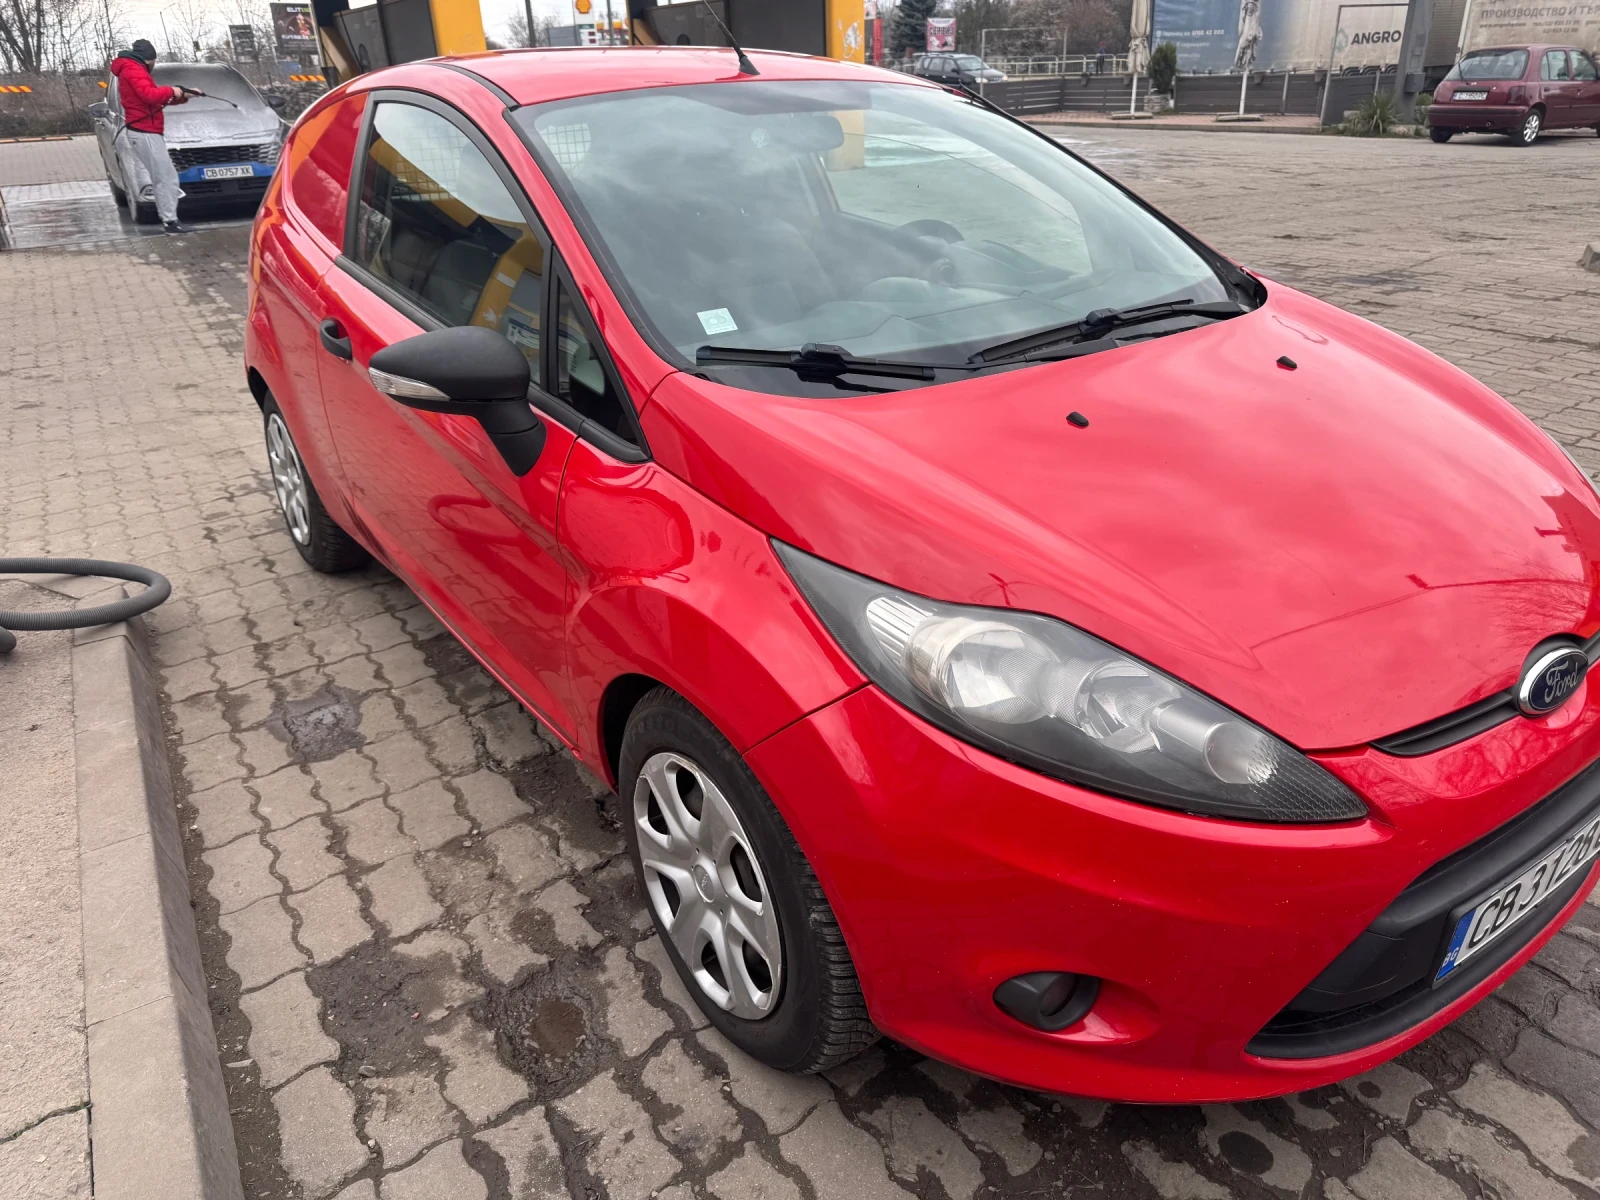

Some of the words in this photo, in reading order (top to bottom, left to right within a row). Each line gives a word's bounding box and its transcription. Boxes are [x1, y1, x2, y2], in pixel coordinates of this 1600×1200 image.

[1481, 6, 1566, 19] ПРОИЗВОДСТВО
[1568, 6, 1577, 16] И
[929, 26, 954, 35] СЕРВИЗ
[1351, 30, 1401, 45] ANGRO
[1545, 660, 1580, 703] Ford
[1468, 882, 1522, 949] CB
[1441, 946, 1460, 967] BG
